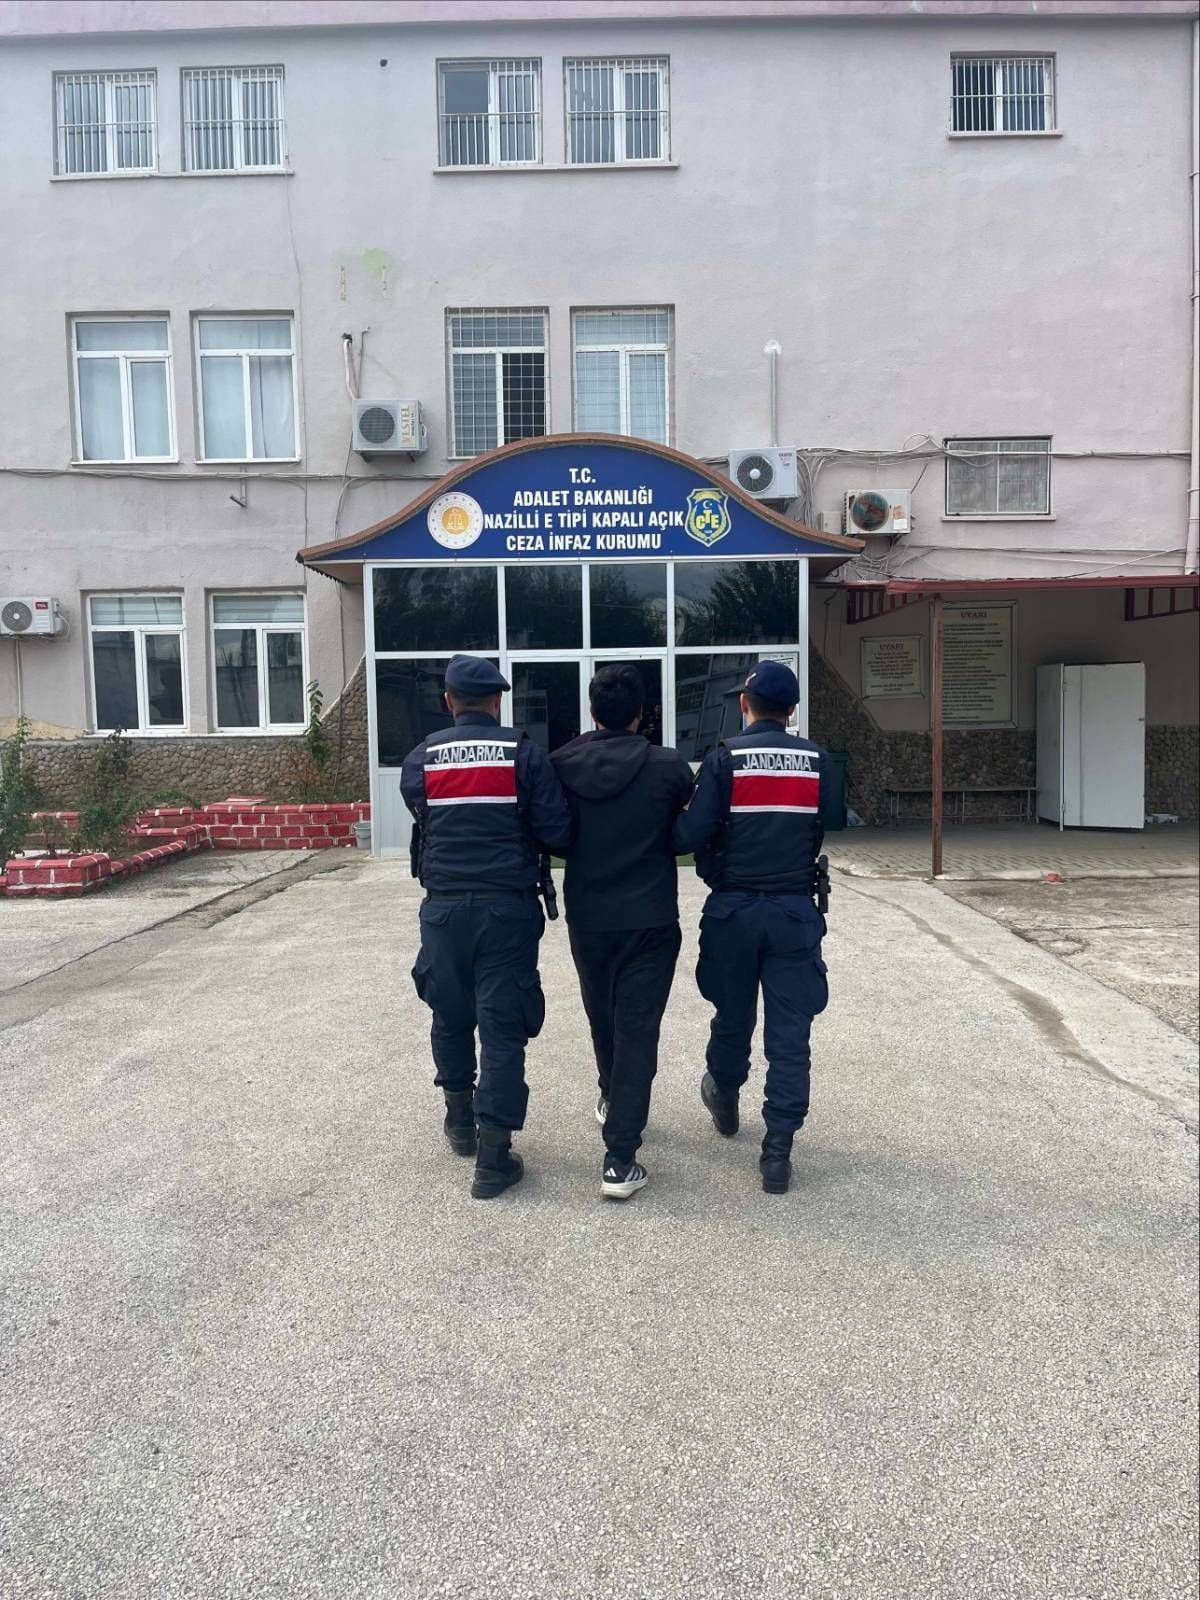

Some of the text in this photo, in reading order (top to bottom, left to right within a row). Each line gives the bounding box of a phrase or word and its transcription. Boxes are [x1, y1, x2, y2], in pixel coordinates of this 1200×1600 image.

[569, 467, 596, 483] T.C.
[514, 486, 653, 506] ADALET BAKANLIĞI
[484, 509, 684, 530] NAZİLLİ E TİPİ KAPALI AÇIK
[696, 510, 719, 529] CTE
[506, 532, 662, 551] CEZA İNFAZ KURUMU
[434, 746, 505, 764] JANDARMA
[742, 754, 811, 771] JANDARMA
